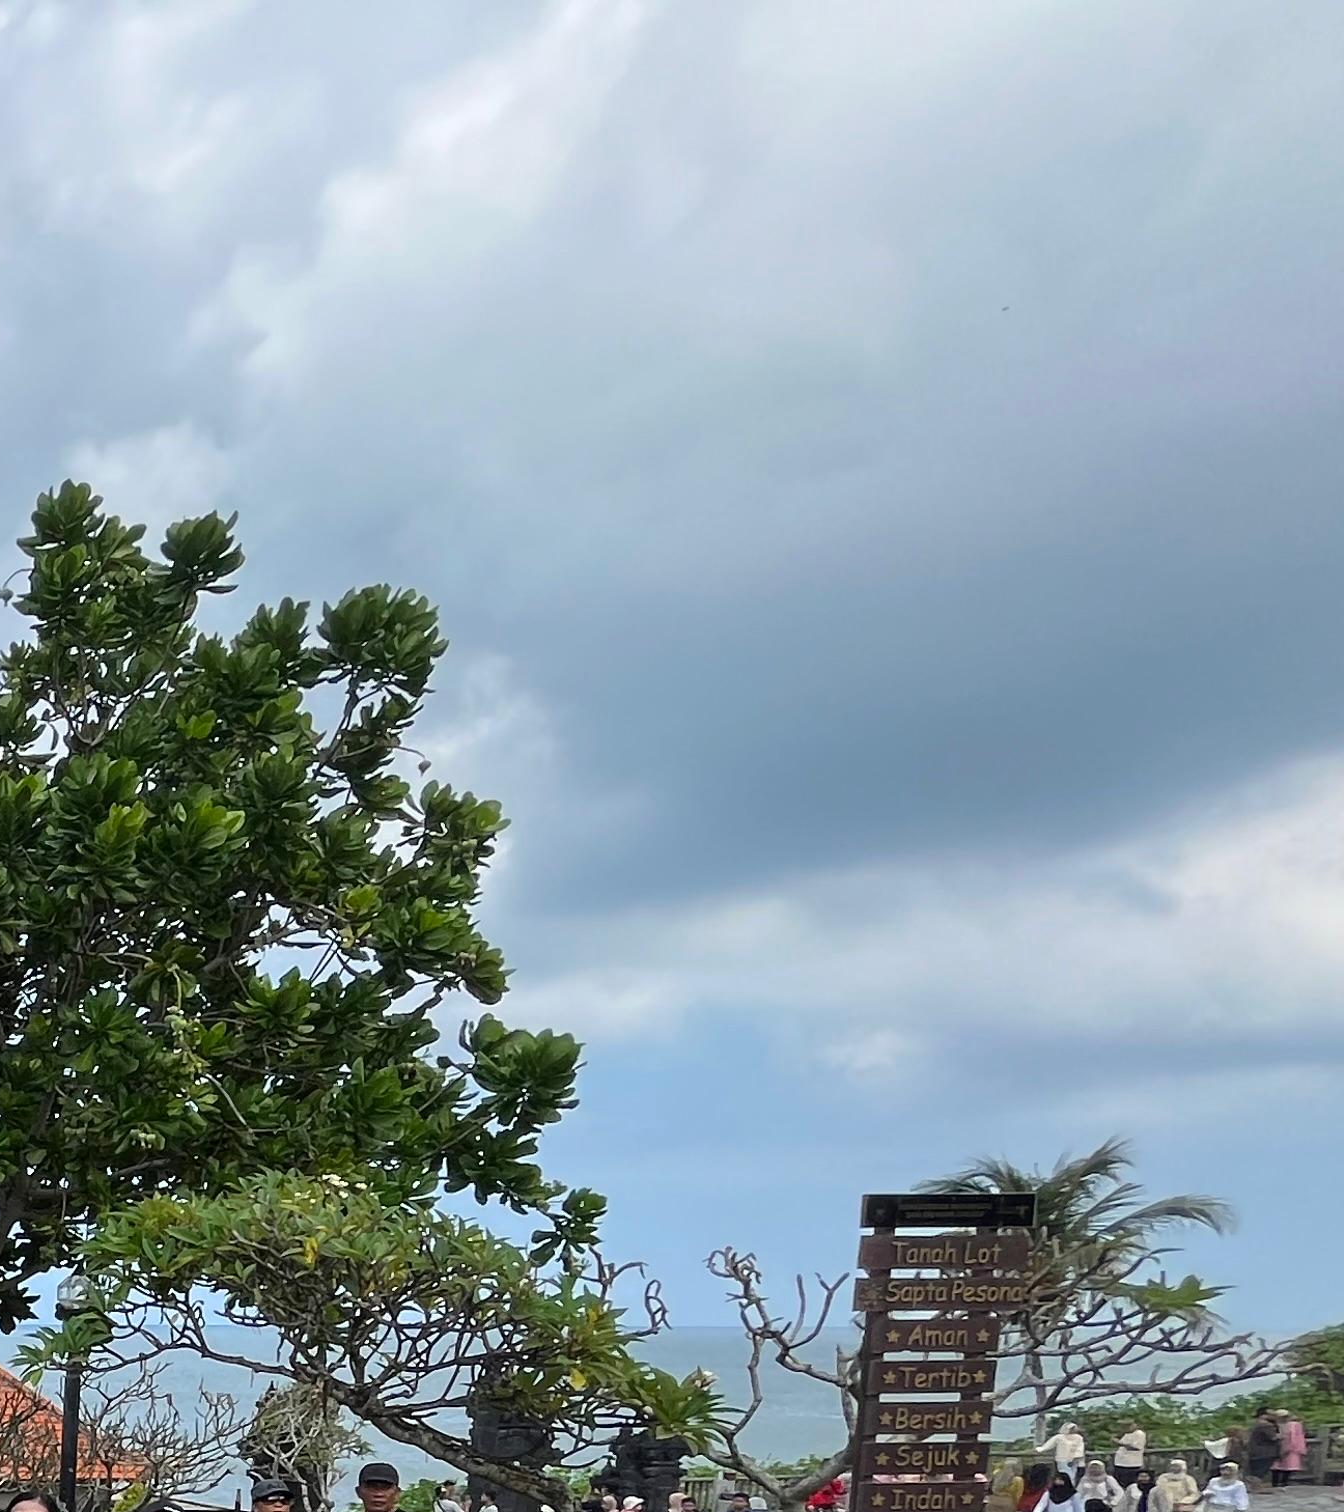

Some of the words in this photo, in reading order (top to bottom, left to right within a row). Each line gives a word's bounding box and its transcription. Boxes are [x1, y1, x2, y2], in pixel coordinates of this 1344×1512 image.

[892, 1240, 957, 1264] Tanah
[964, 1241, 1002, 1264] Lot
[886, 1281, 947, 1306] Sapta
[951, 1279, 1025, 1303] Pesona
[908, 1324, 968, 1346] Aman
[898, 1366, 971, 1388] Tertib
[895, 1407, 966, 1429] Bersih
[894, 1445, 960, 1472] Sejuk
[890, 1488, 956, 1510] Indah
